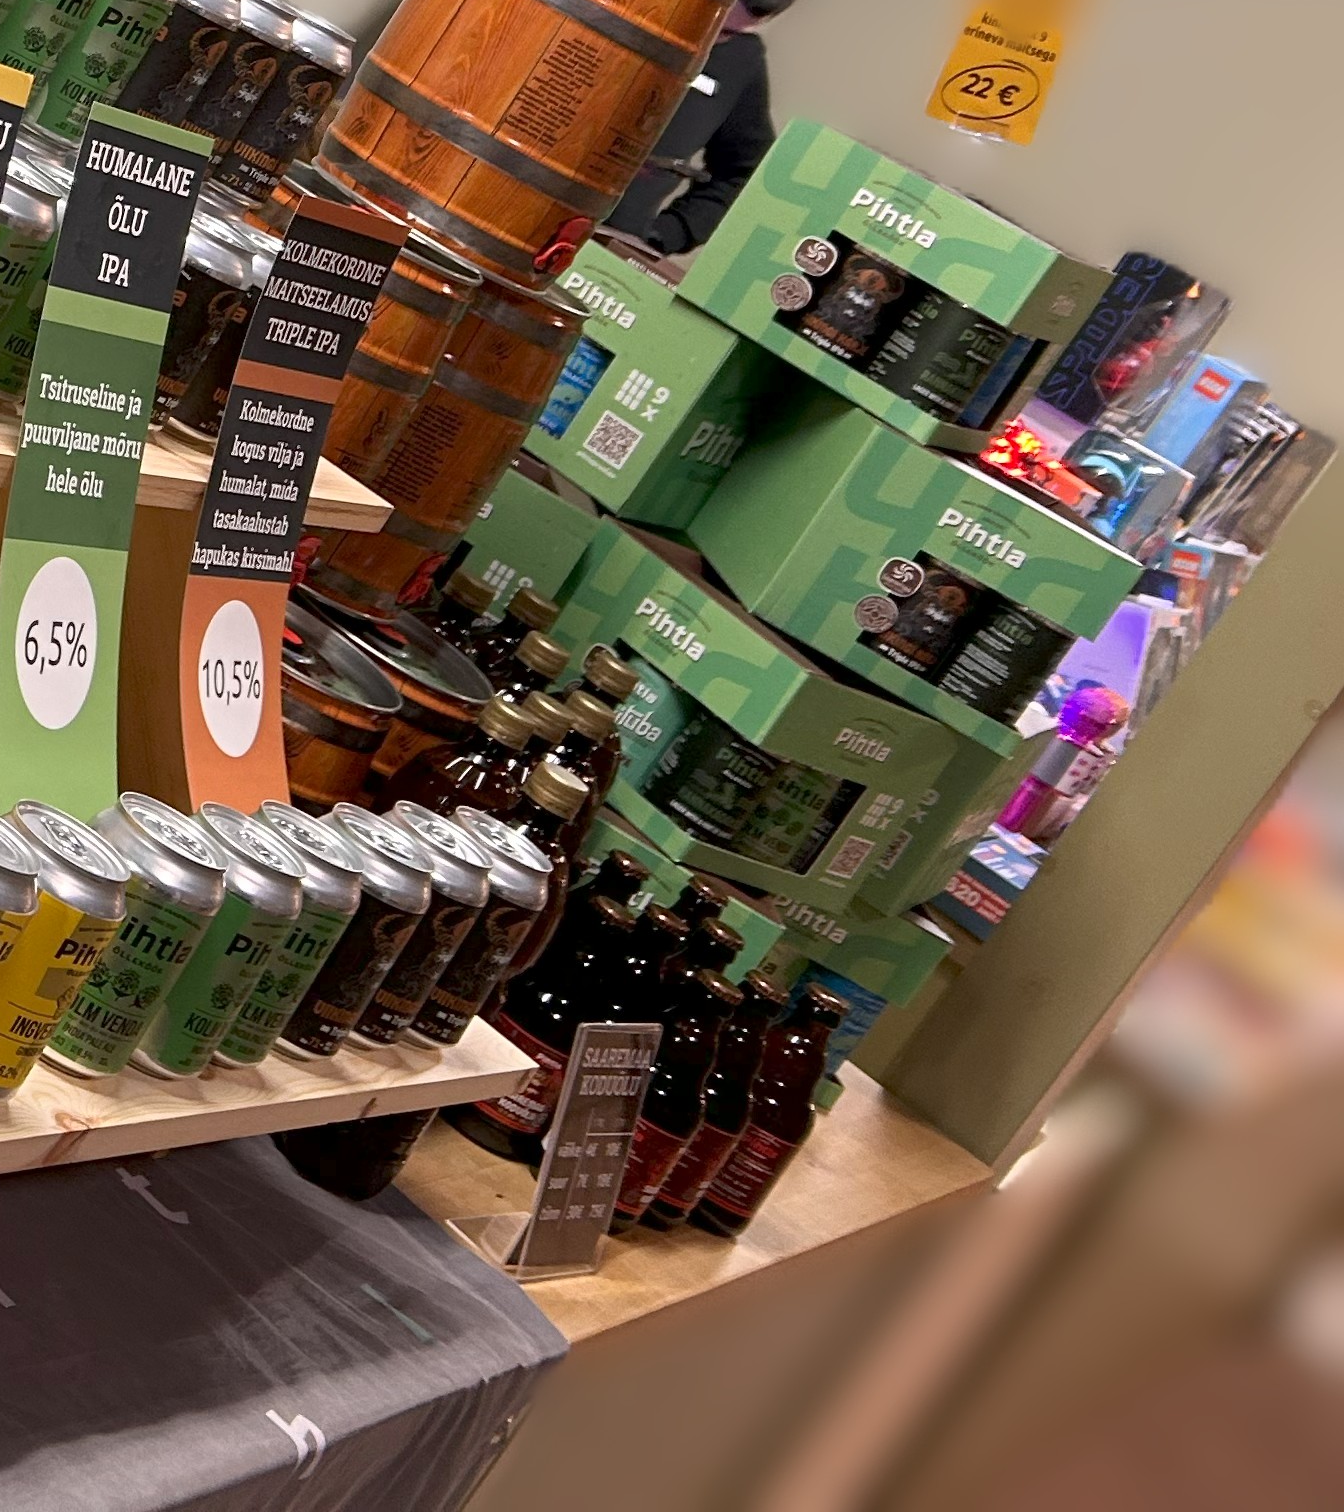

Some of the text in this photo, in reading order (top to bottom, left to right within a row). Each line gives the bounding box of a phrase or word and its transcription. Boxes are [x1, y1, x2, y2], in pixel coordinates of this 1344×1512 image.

[963, 26, 1004, 46] erineva
[959, 73, 1021, 106] 22 €
[85, 139, 195, 199] HUMALANE
[107, 195, 149, 238] ÕLU
[848, 186, 938, 249] Pihtla
[96, 252, 132, 288] IPA
[281, 238, 387, 287] KOLMEKORDNE
[263, 276, 375, 323] MAITSEELAMUS
[562, 270, 637, 331] Pihtla
[264, 317, 343, 356] TRIPLE IPA
[39, 373, 143, 416] Tsitruseline ja
[655, 386, 672, 406] 9
[239, 399, 315, 435] Kolmekordne
[21, 421, 142, 461] puuviljane mõru
[231, 434, 306, 468] kogus vilja ja
[45, 465, 104, 499] hele õlu
[218, 469, 299, 502] humalat, mida
[212, 508, 289, 536] tasakaalustab
[937, 506, 1027, 570] Pihtla
[192, 541, 241, 570] hapukas
[23, 619, 88, 676] 6,5%
[633, 594, 707, 663] Pihtla
[201, 658, 262, 706] 10,5%
[832, 727, 892, 763] Pihtla
[773, 892, 848, 946] Pihtla
